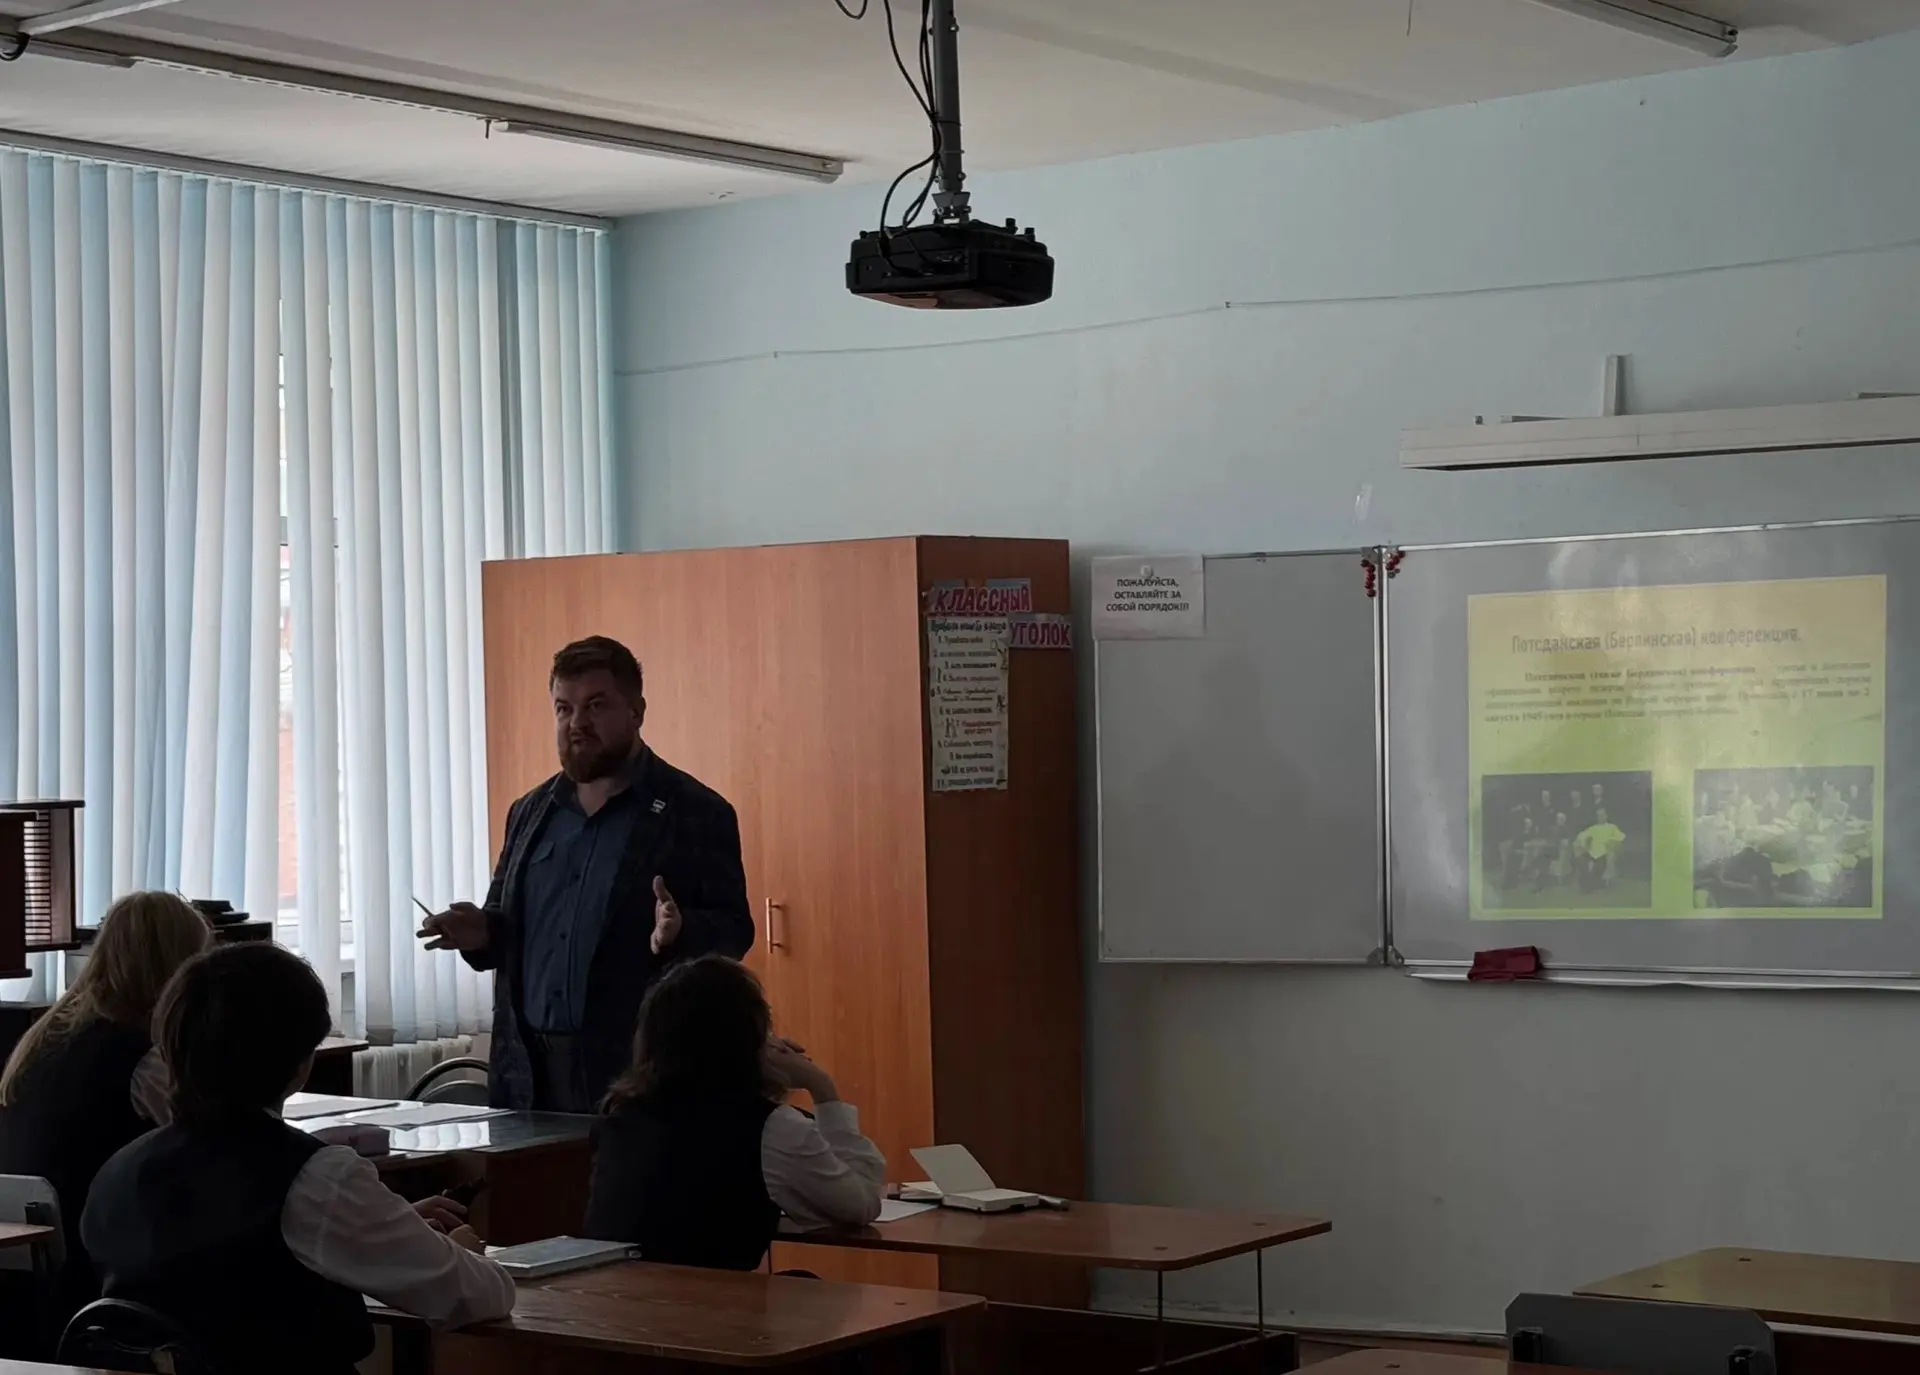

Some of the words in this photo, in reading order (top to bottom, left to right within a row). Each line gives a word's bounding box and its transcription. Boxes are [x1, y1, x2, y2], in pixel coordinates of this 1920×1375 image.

[1117, 577, 1179, 588] ПОЖАЛУЙСТА,
[935, 586, 1030, 612] КЛАССНЫЙ
[1114, 589, 1169, 599] ОСТАВЛЯЙТЕ
[1171, 591, 1182, 599] ЗА
[1106, 602, 1136, 612] СОБОЙ
[1138, 602, 1190, 612] ПОРЯДОК!!!
[1010, 622, 1070, 646] УГОЛОК
[1604, 627, 1696, 651] (Берлинская)
